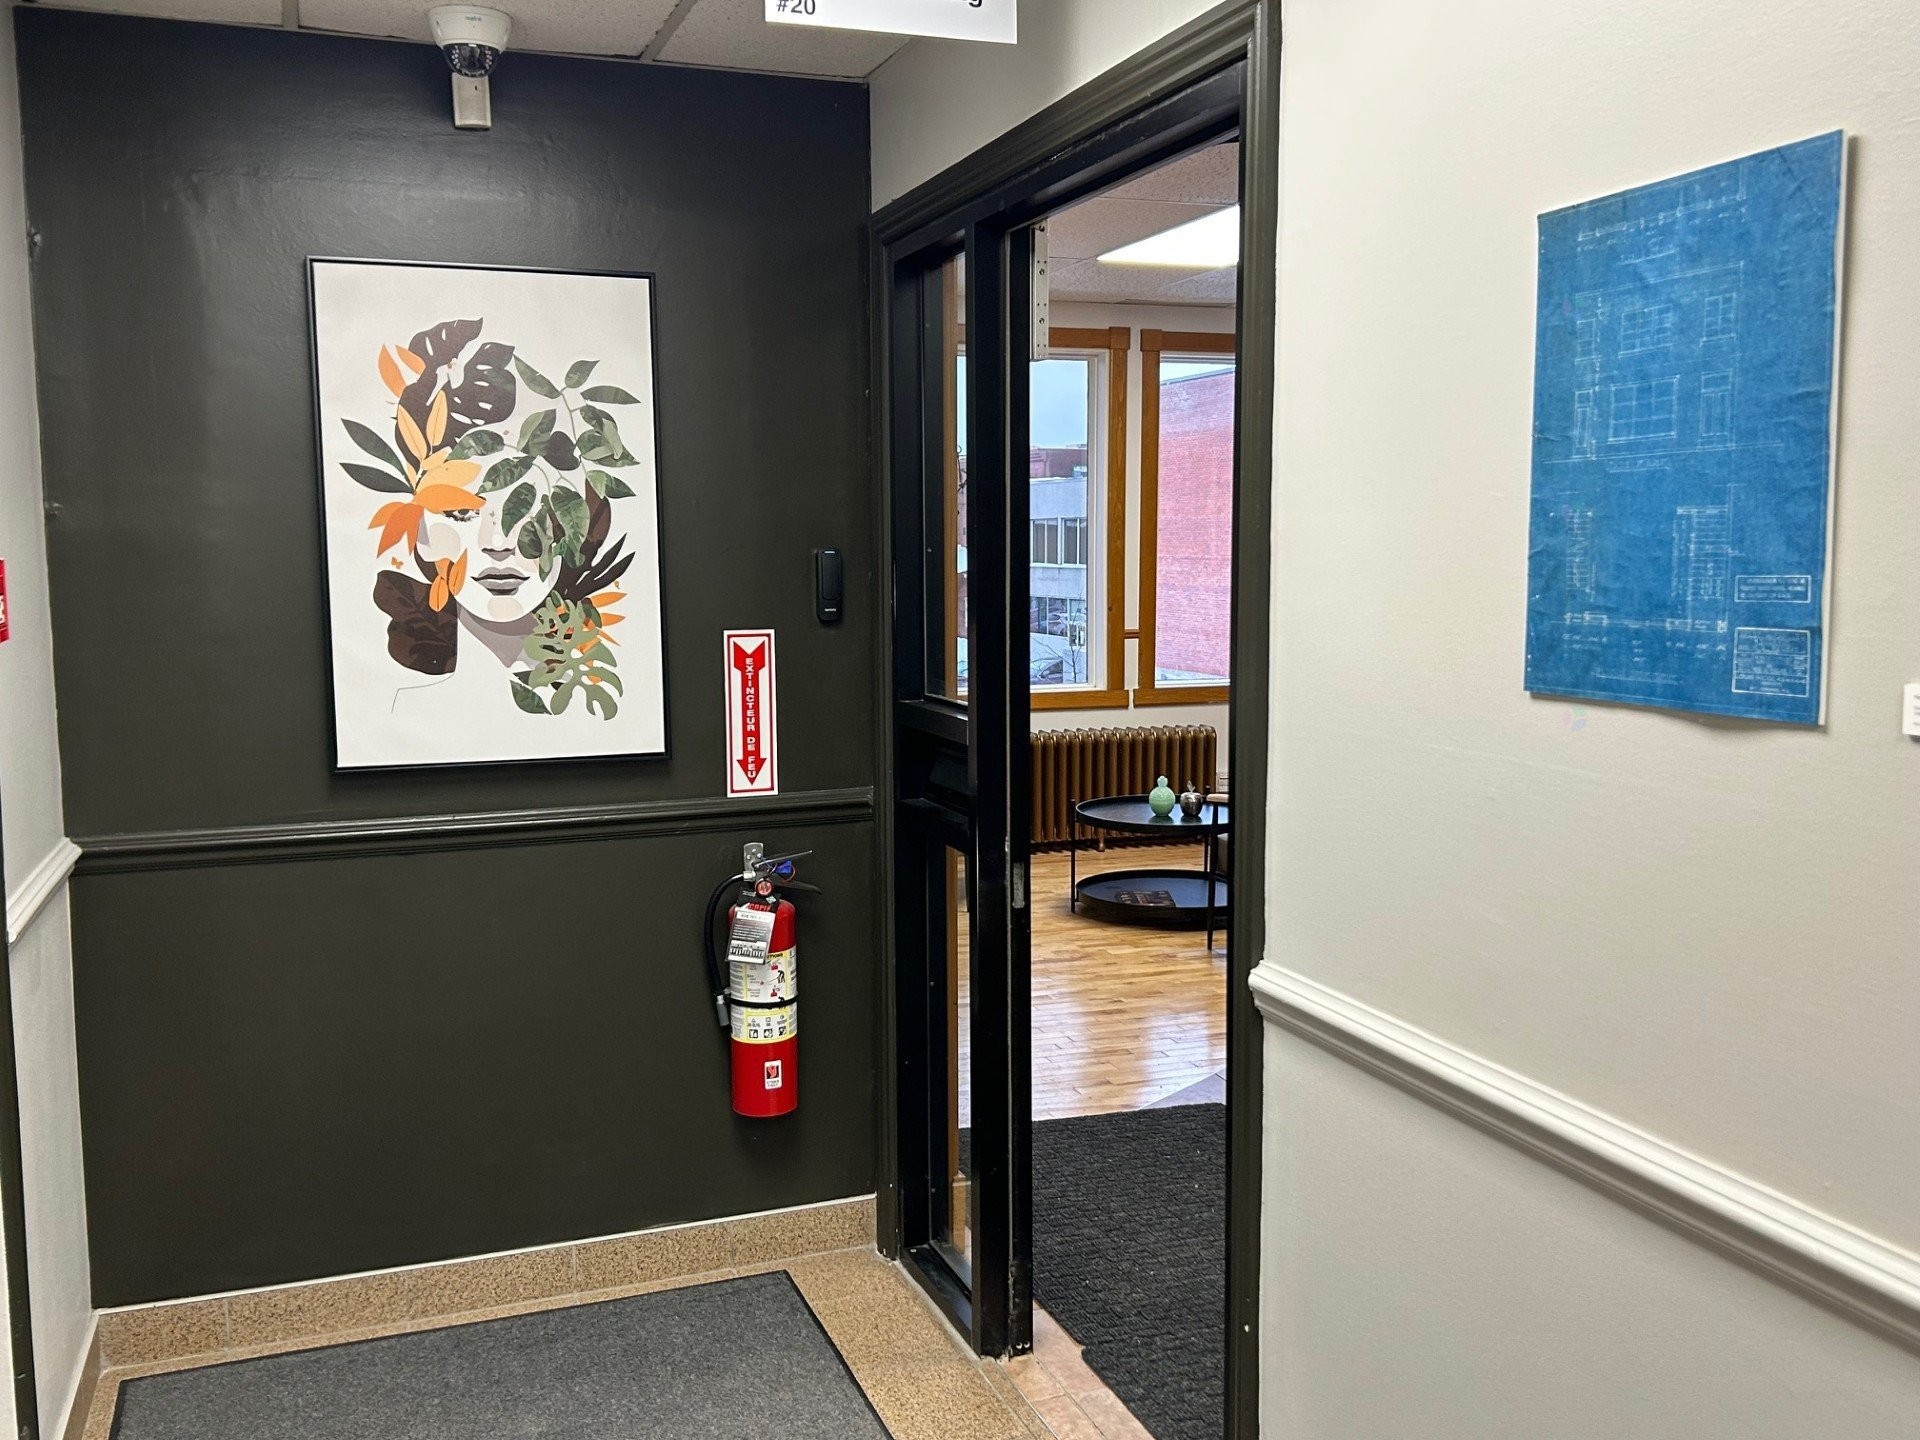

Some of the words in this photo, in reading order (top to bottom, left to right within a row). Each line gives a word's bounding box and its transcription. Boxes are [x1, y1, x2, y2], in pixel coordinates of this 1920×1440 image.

[745, 657, 756, 732] EXTINCTEUR
[746, 736, 756, 751] DE
[747, 755, 757, 778] FEU
